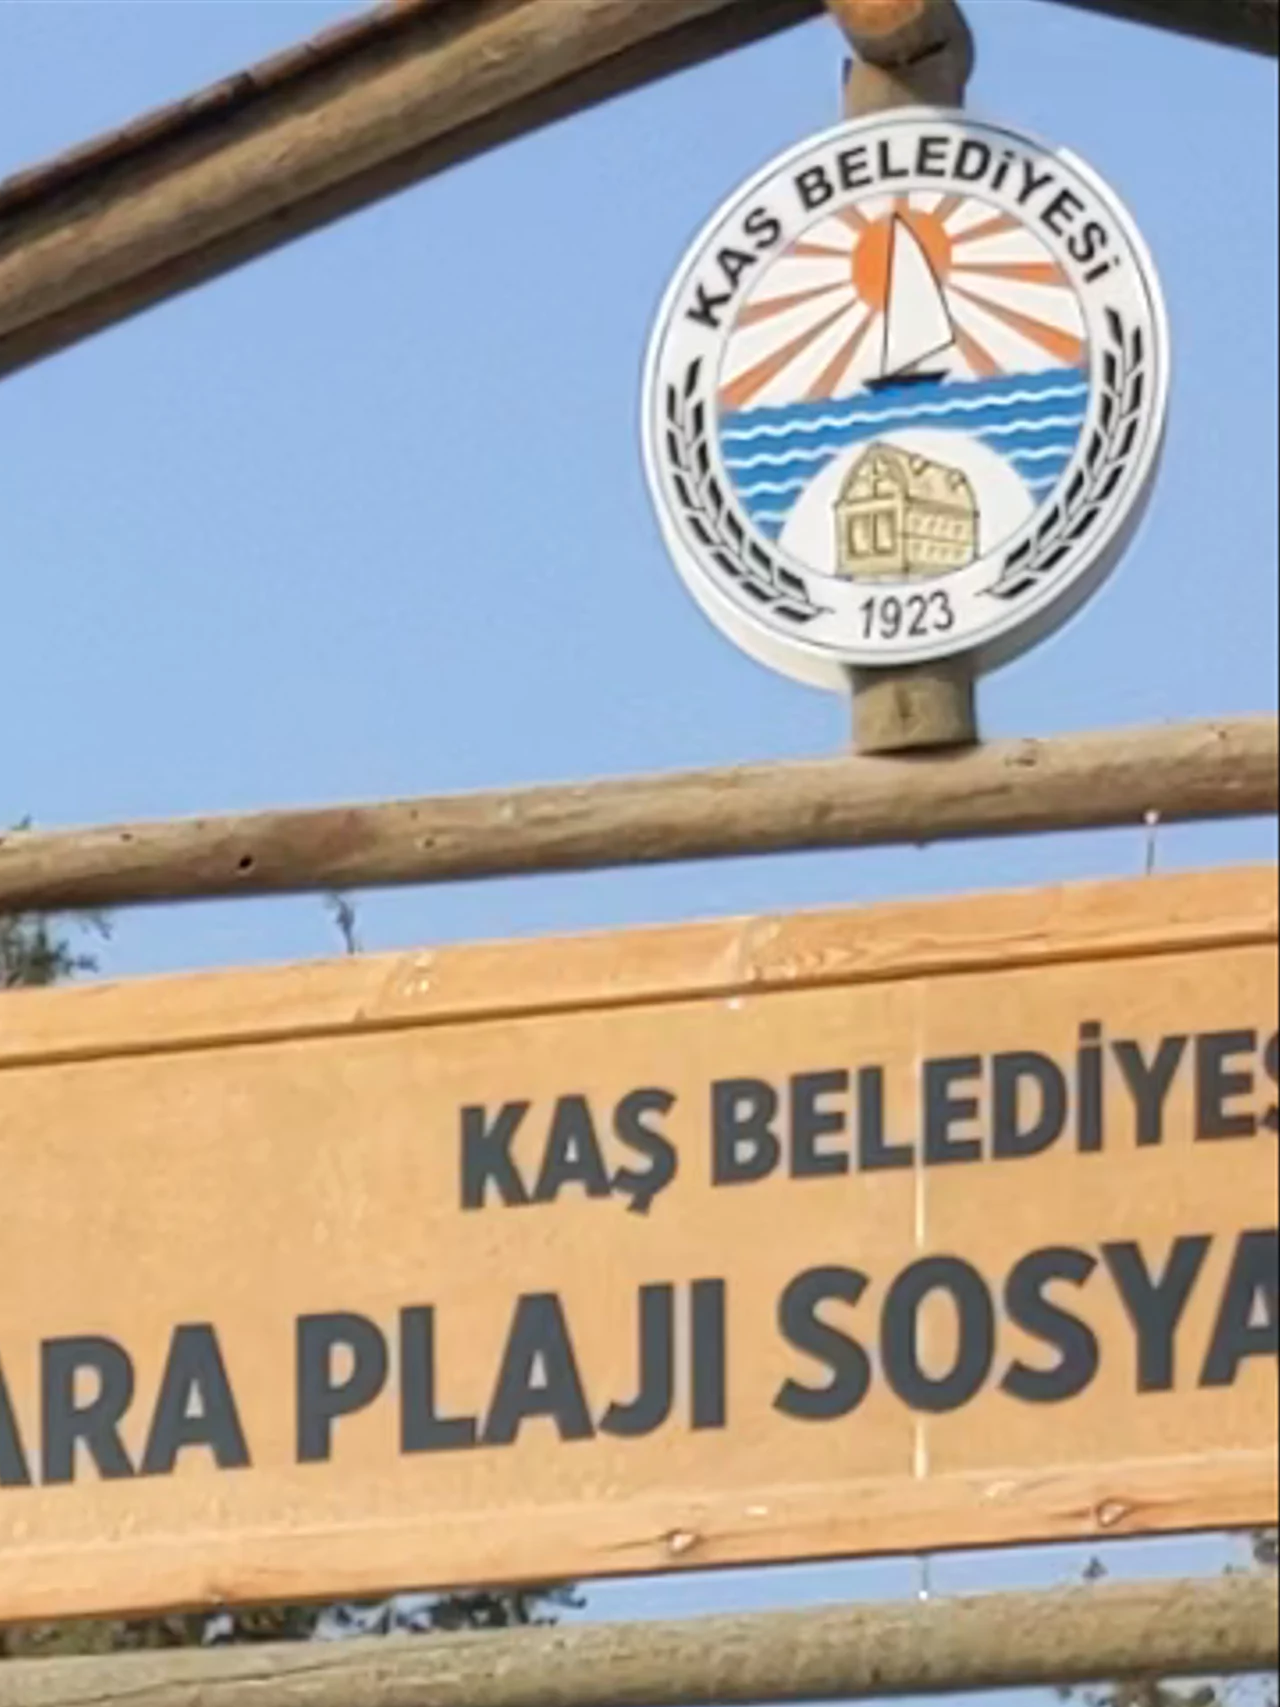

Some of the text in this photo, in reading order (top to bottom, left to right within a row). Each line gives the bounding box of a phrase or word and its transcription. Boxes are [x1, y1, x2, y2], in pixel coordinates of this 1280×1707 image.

[859, 589, 955, 639] 1923
[461, 1019, 1278, 1214] KAŞ BELEDİYE
[296, 1277, 727, 1464] PLAJI
[772, 1227, 1278, 1421] SOSYA
